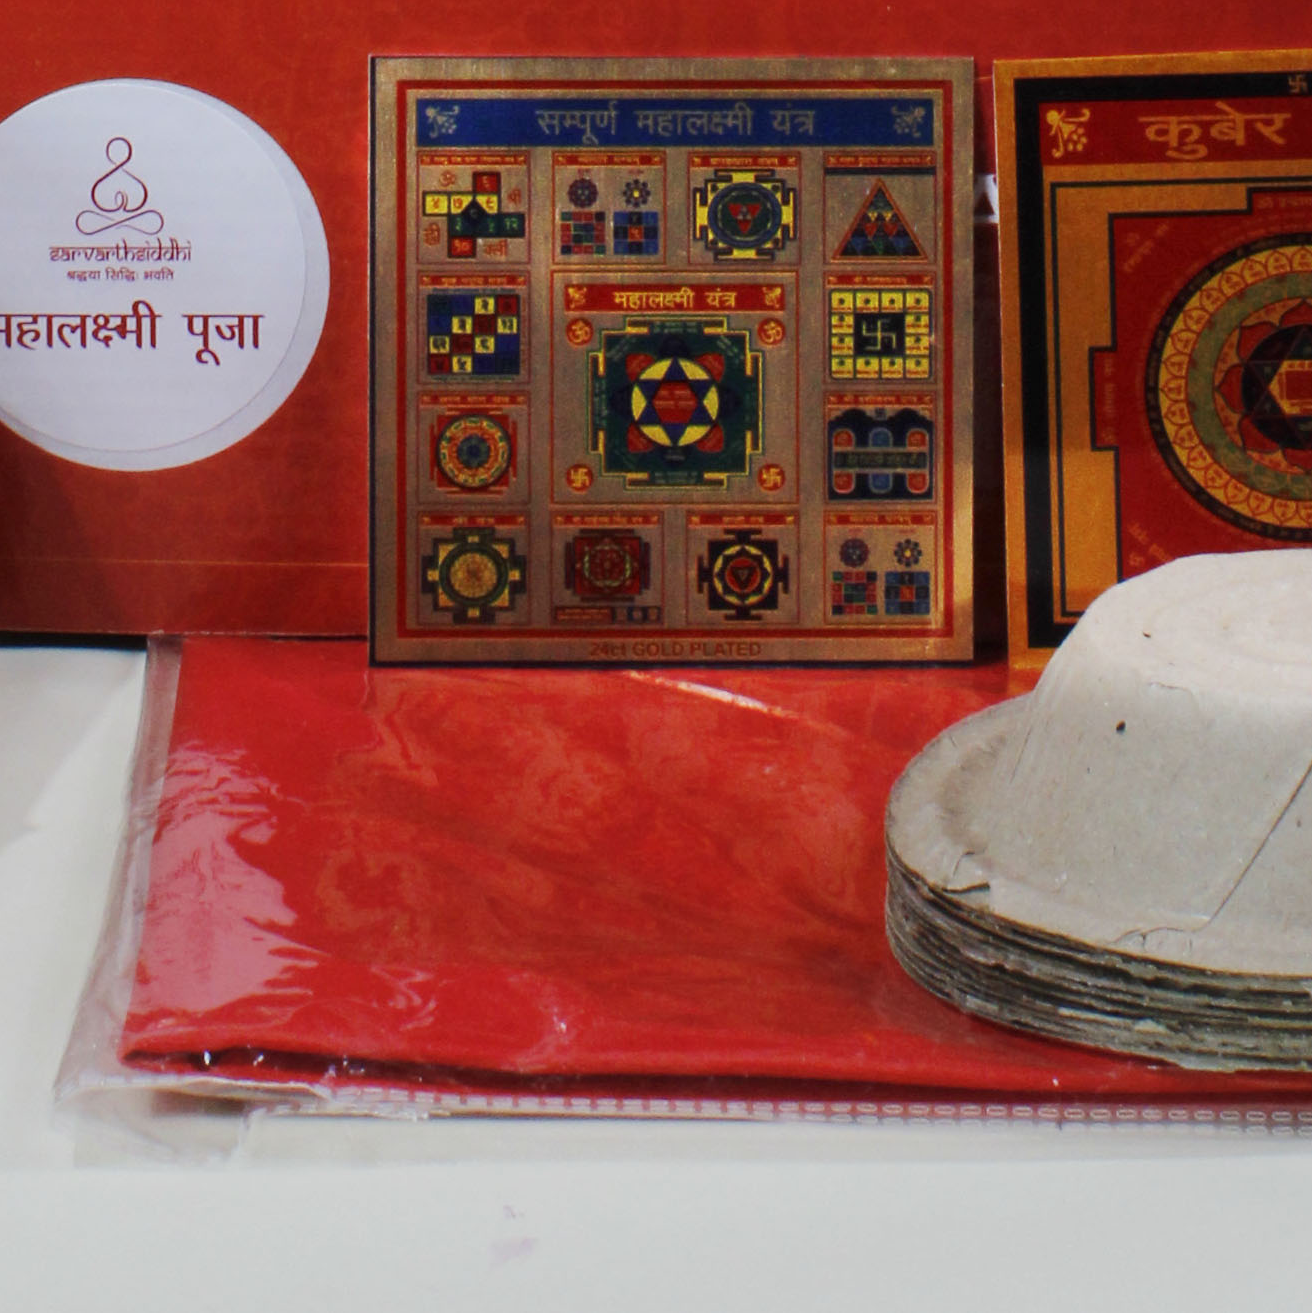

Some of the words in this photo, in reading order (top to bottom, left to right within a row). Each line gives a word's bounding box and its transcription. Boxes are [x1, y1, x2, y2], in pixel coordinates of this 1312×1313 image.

[536, 100, 619, 143] सम्पूर्ण
[636, 100, 755, 136] महालक्ष्मी
[772, 102, 816, 136] यंत्र
[1137, 101, 1292, 161] कुबेर
[613, 286, 696, 309] महालक्ष्मी
[704, 287, 738, 309] यंत्र
[182, 309, 265, 365] पूजा
[631, 641, 685, 658] GOLD
[690, 641, 761, 658] PLATED
